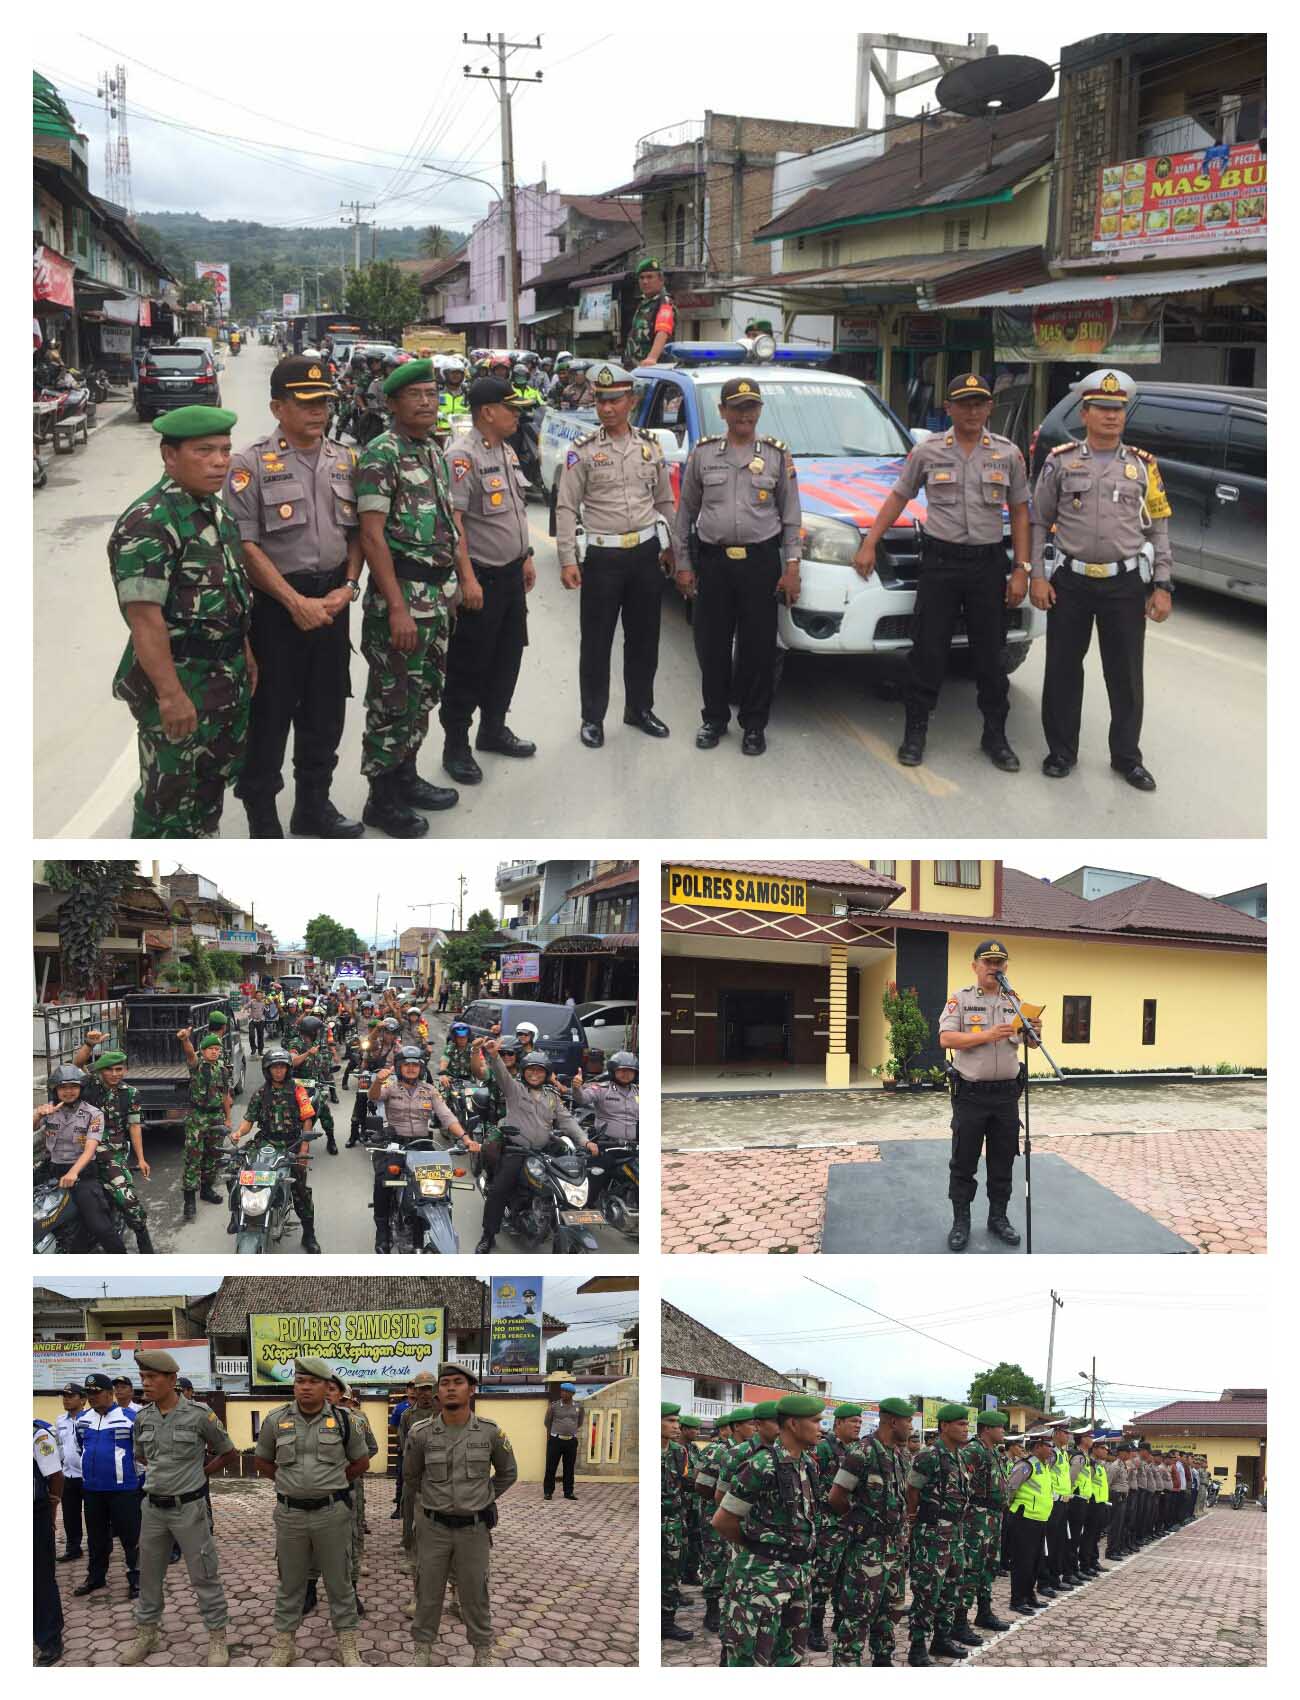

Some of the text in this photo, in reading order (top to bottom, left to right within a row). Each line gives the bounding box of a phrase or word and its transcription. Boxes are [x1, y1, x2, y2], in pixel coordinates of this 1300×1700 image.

[1150, 175, 1211, 199] MAS
[1219, 165, 1267, 189] BU
[1040, 321, 1108, 340] MAS BUDI
[671, 873, 805, 907] POLRES SAMOSIR
[279, 1313, 420, 1342] POLRES SAMOSIR
[63, 1342, 86, 1351] WISH
[263, 1341, 432, 1365] Negeri Indah Kepingan Surga
[336, 1364, 411, 1379] Dengan Kasih
